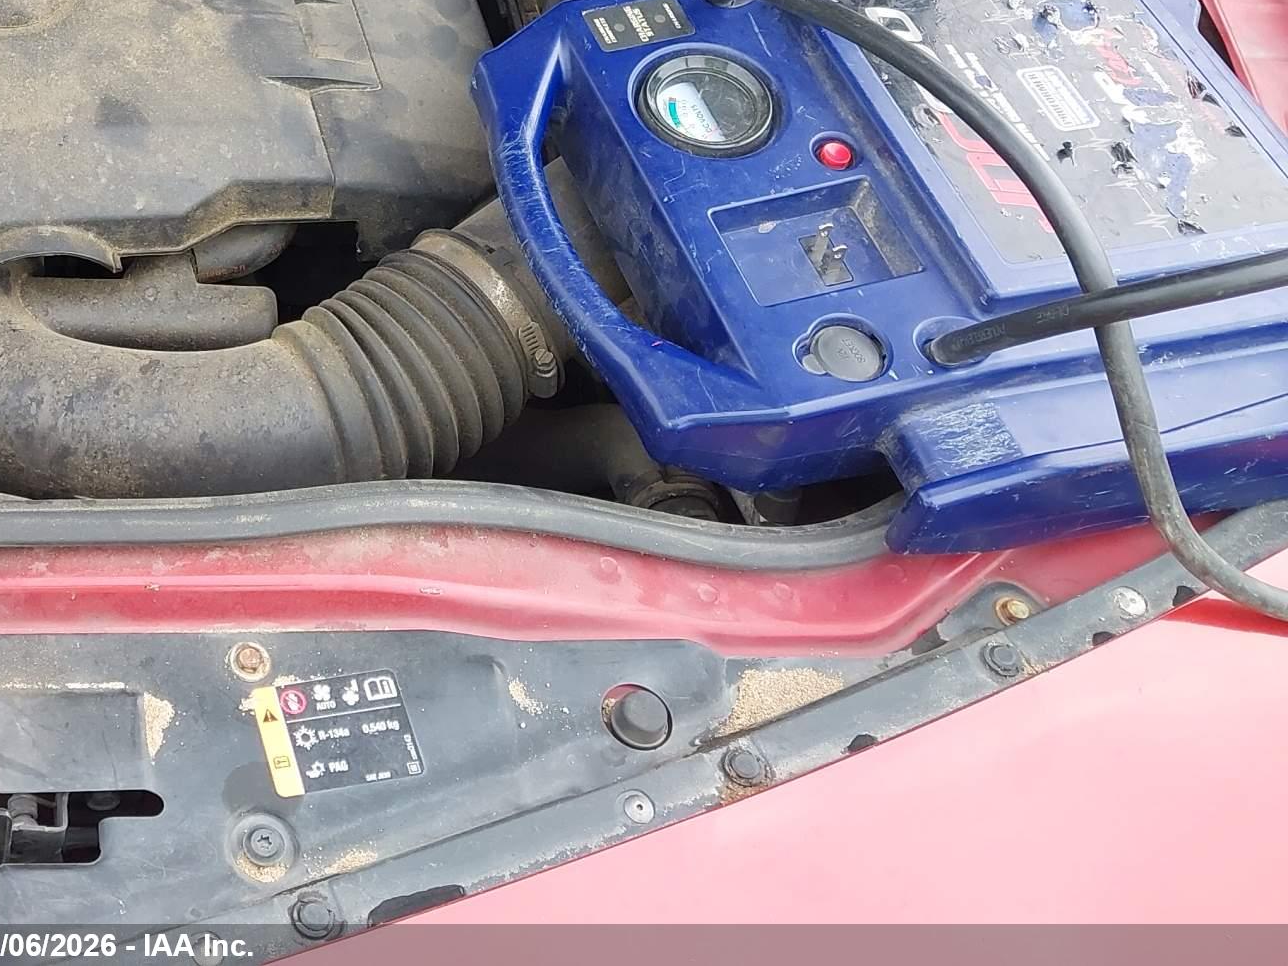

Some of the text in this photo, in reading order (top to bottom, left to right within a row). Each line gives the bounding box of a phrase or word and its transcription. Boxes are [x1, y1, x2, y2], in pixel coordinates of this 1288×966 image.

[623, 6, 649, 42] CHARGING
[632, 8, 655, 37] STATUS
[316, 700, 336, 711] AUTO
[318, 719, 400, 741] R-134a 0.540 kg
[328, 760, 349, 773] PAG
